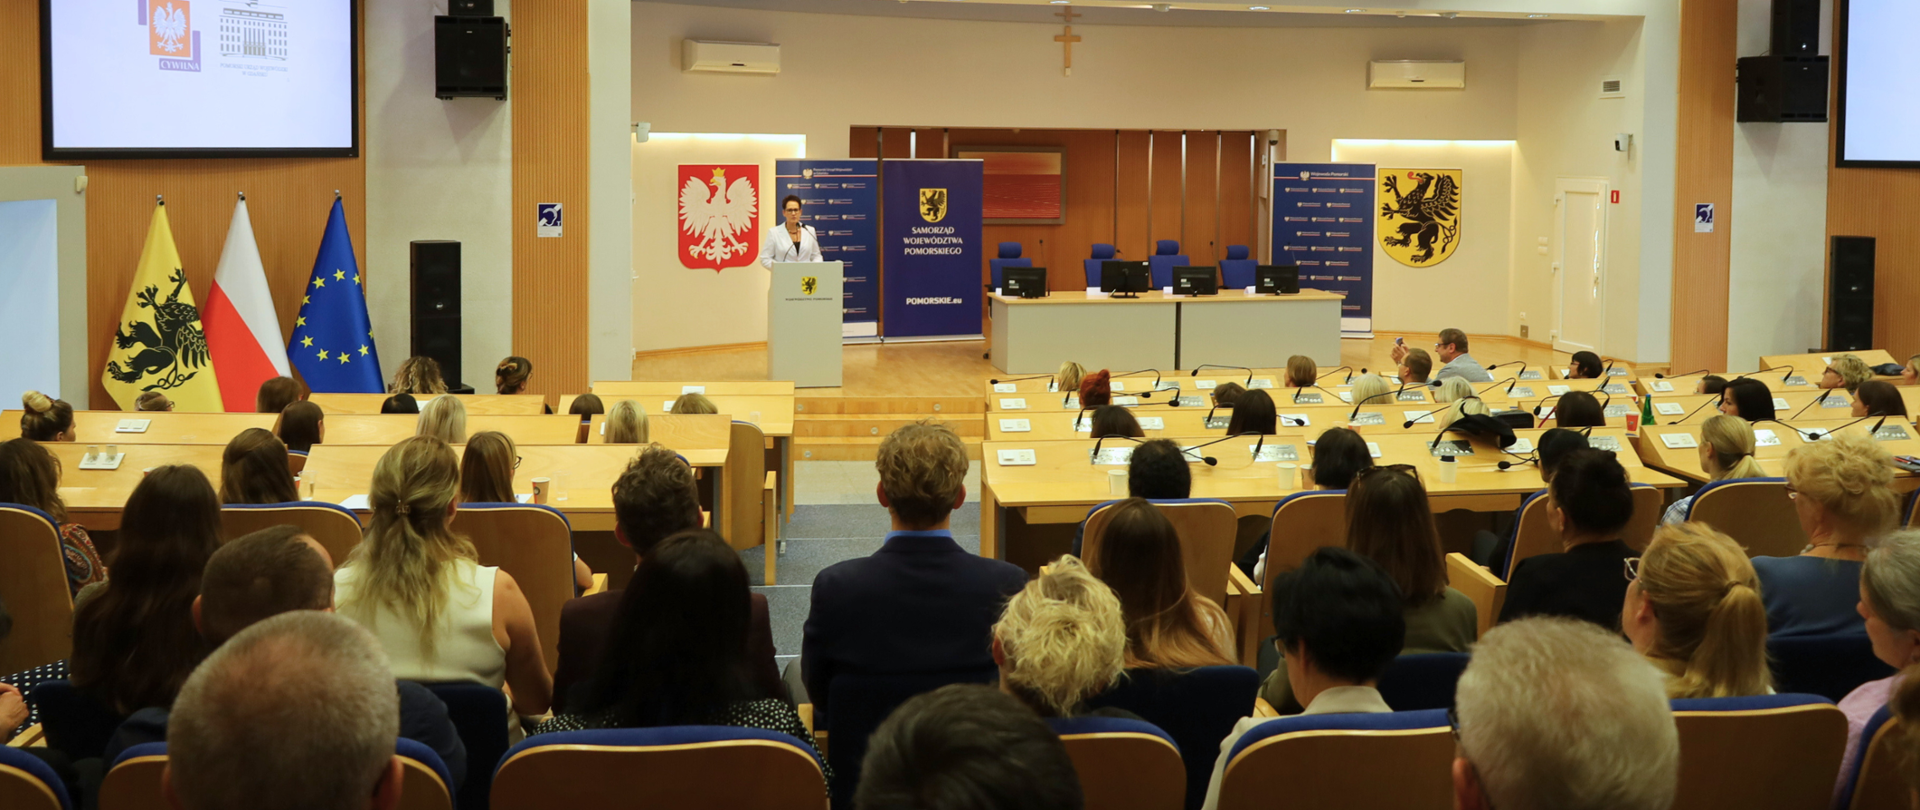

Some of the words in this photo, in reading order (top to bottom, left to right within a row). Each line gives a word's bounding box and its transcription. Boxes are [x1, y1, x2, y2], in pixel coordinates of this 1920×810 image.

[160, 60, 200, 71] CYWILNA
[911, 226, 955, 235] SAMORZĄD
[903, 235, 963, 245] WOJEWÓDZTWA
[904, 247, 962, 255] POMORSKIEGO
[906, 296, 962, 305] POMORSKIE.eu
